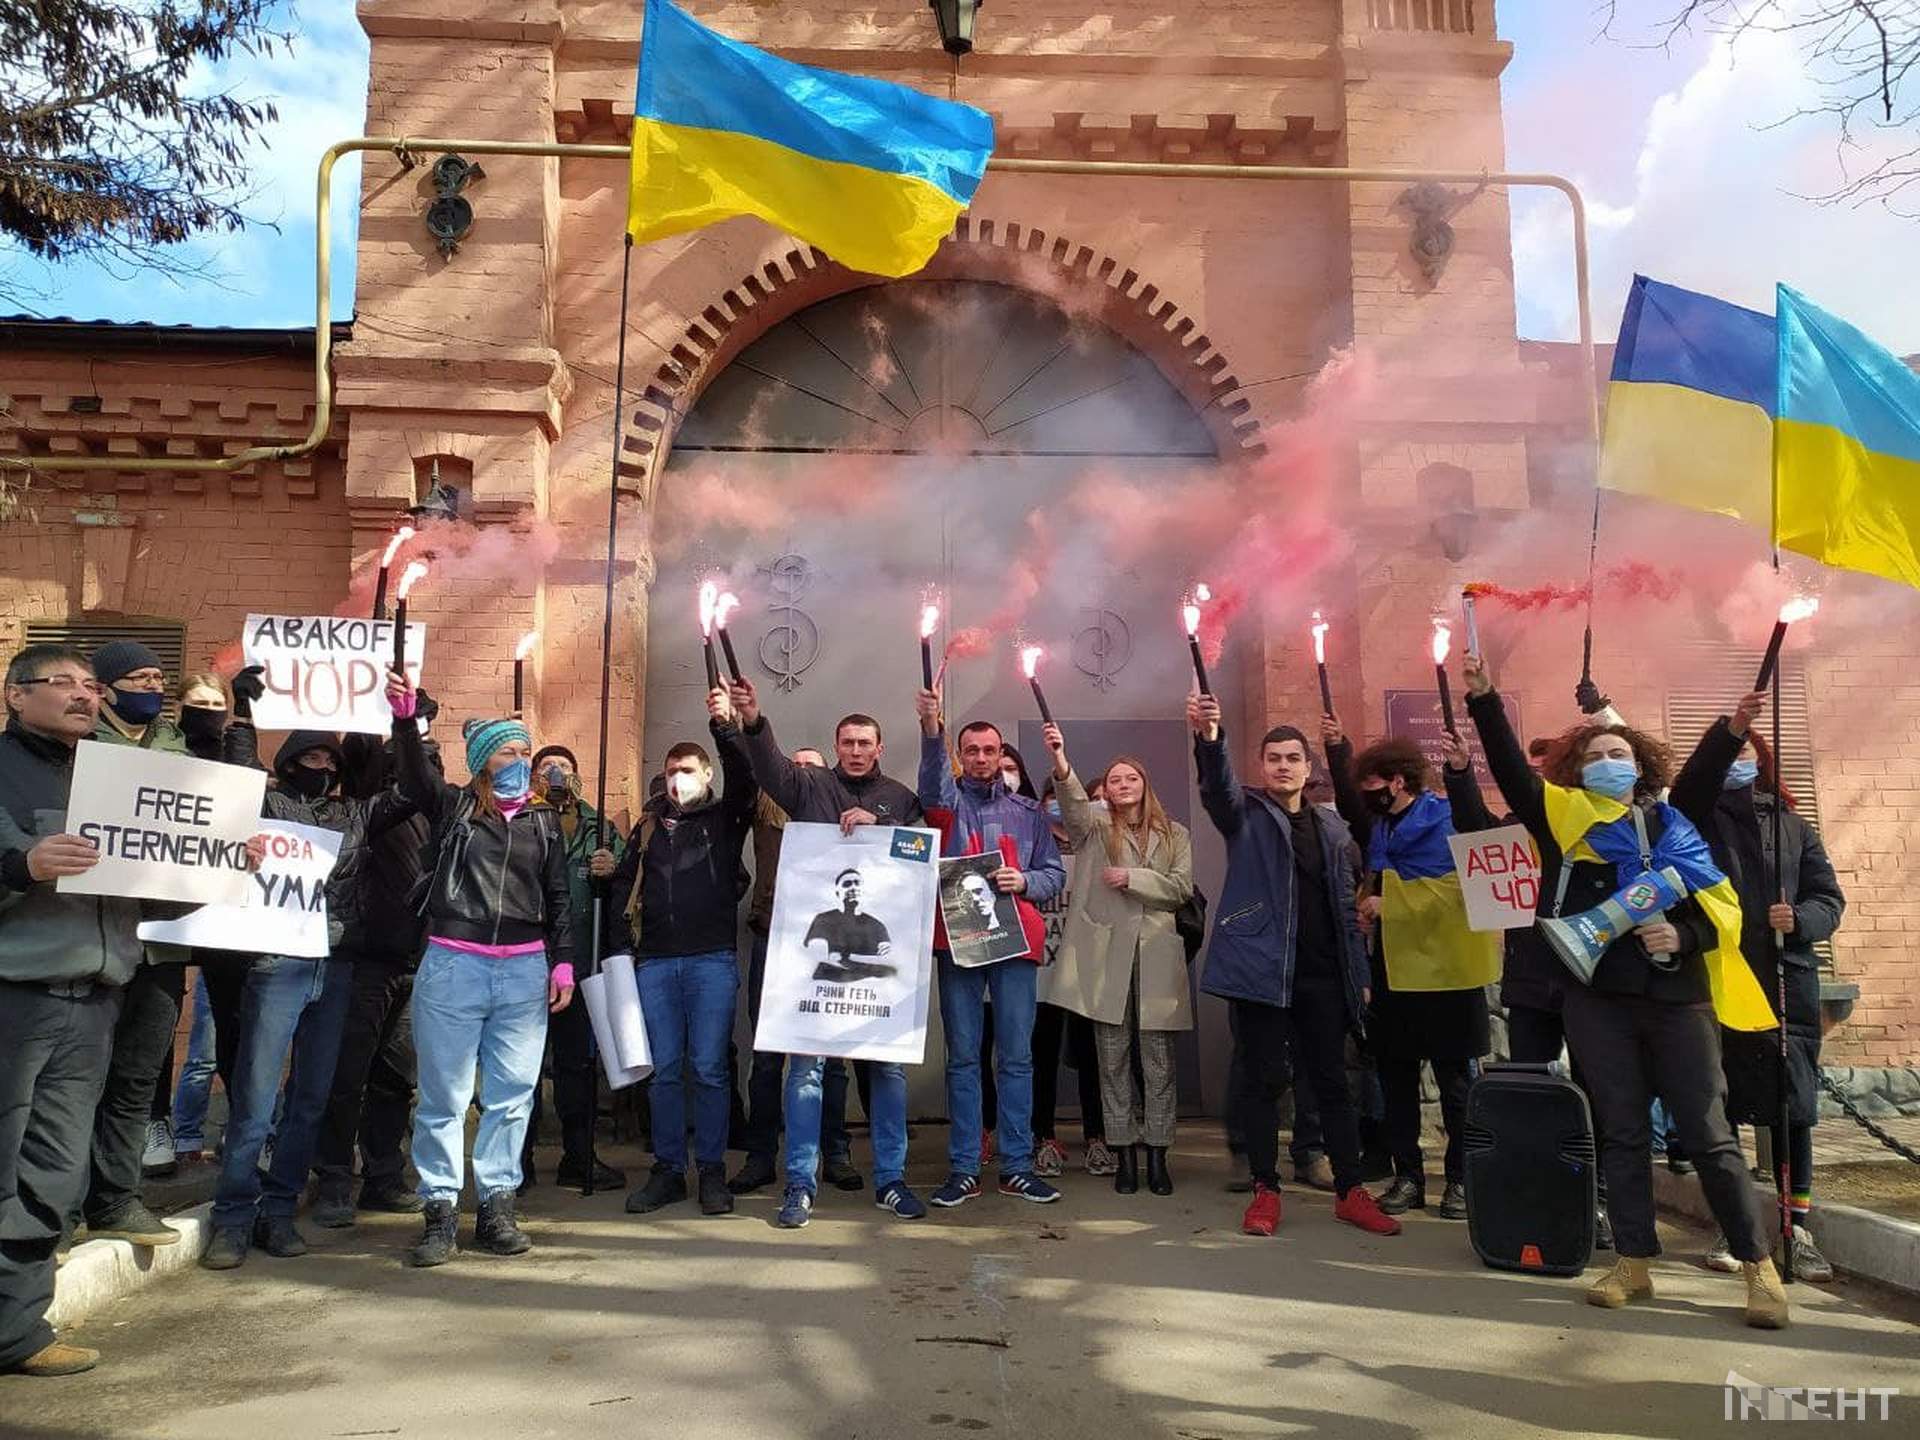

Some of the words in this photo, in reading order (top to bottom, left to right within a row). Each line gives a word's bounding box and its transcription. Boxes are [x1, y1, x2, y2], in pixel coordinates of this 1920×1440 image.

[134, 787, 214, 827] FREE
[79, 823, 248, 871] STERNENKO
[1468, 840, 1538, 877] АВА
[1491, 876, 1542, 910] ЧО
[849, 986, 878, 1001] ГЕТЬ
